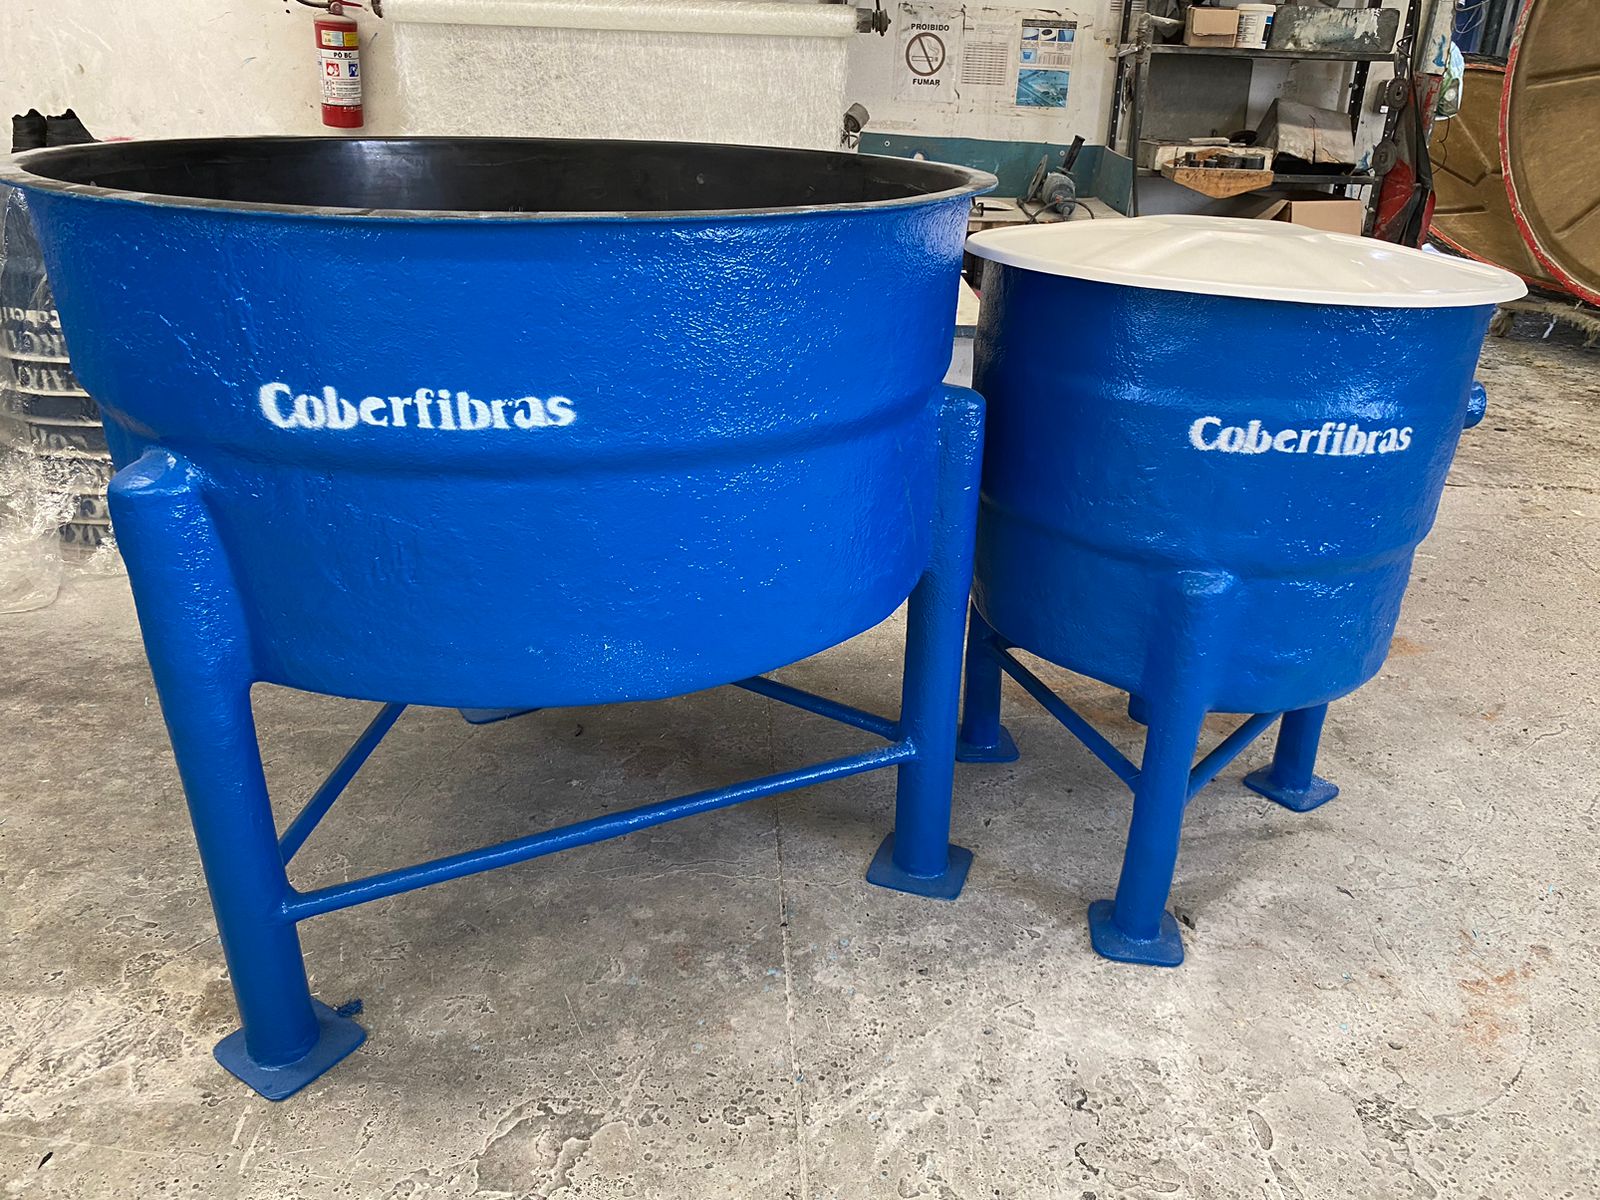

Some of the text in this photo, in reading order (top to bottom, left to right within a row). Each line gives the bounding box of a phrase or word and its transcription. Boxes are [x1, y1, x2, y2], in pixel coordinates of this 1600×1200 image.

[911, 23, 950, 31] PROIBIDO
[912, 78, 941, 86] FUMAR
[258, 381, 576, 430] Coberfibras
[1188, 415, 1413, 456] Coberfibras
